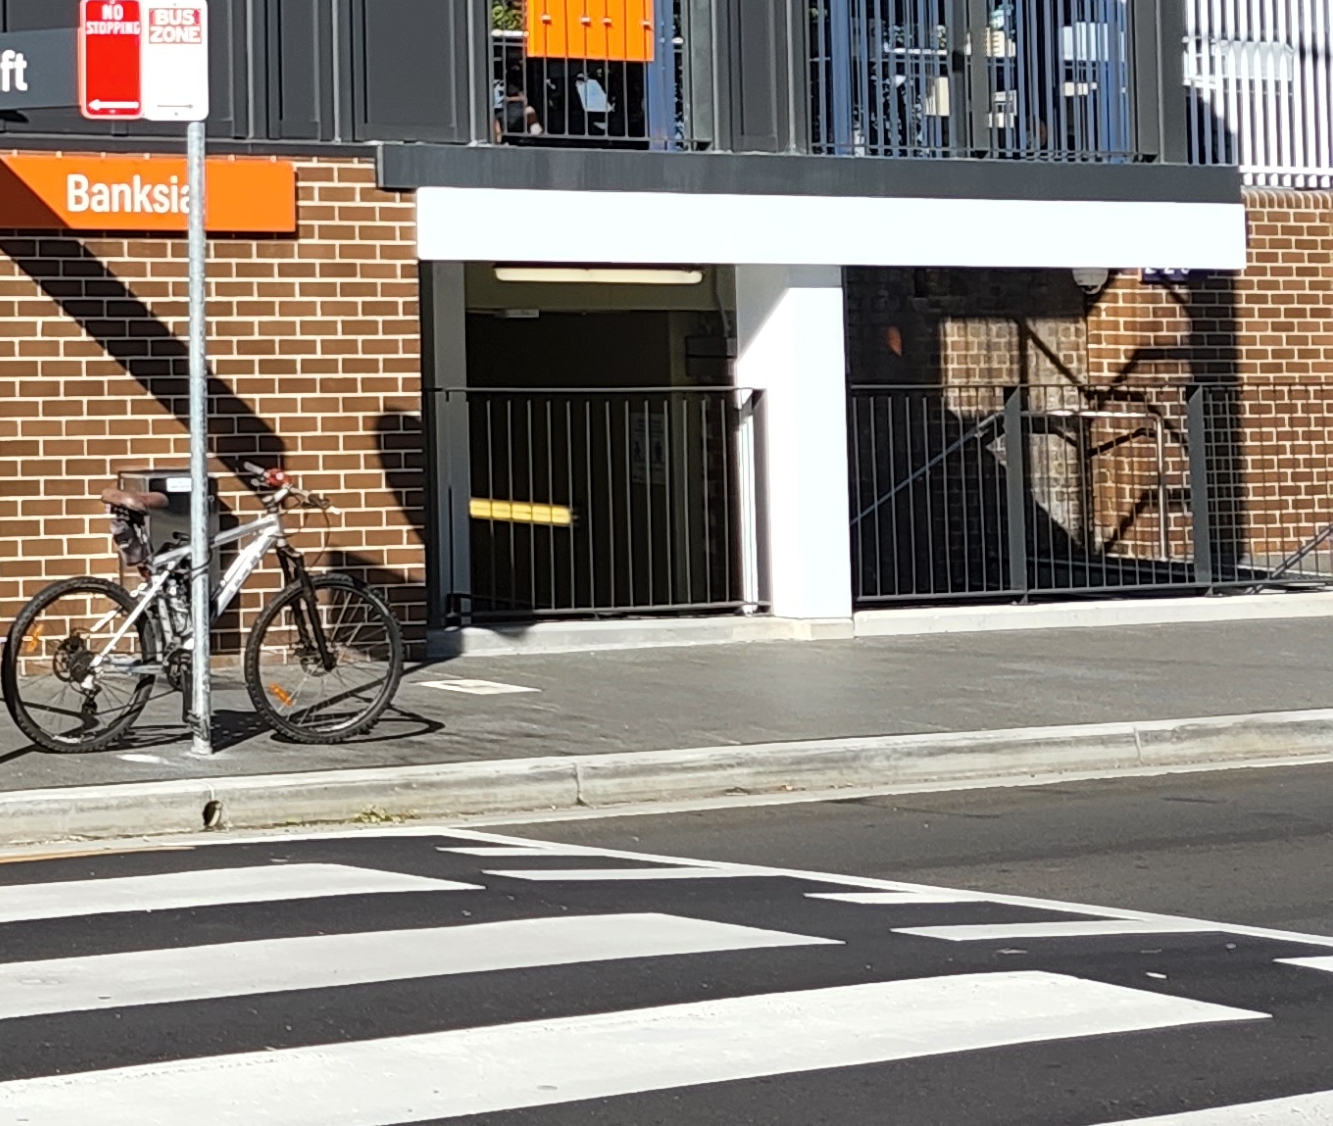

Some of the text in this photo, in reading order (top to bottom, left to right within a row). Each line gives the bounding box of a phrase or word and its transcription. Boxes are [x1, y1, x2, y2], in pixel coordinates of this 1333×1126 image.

[101, 4, 124, 21] NO
[155, 9, 195, 25] BUS
[86, 21, 141, 35] STOPPING
[150, 26, 201, 43] ZONE
